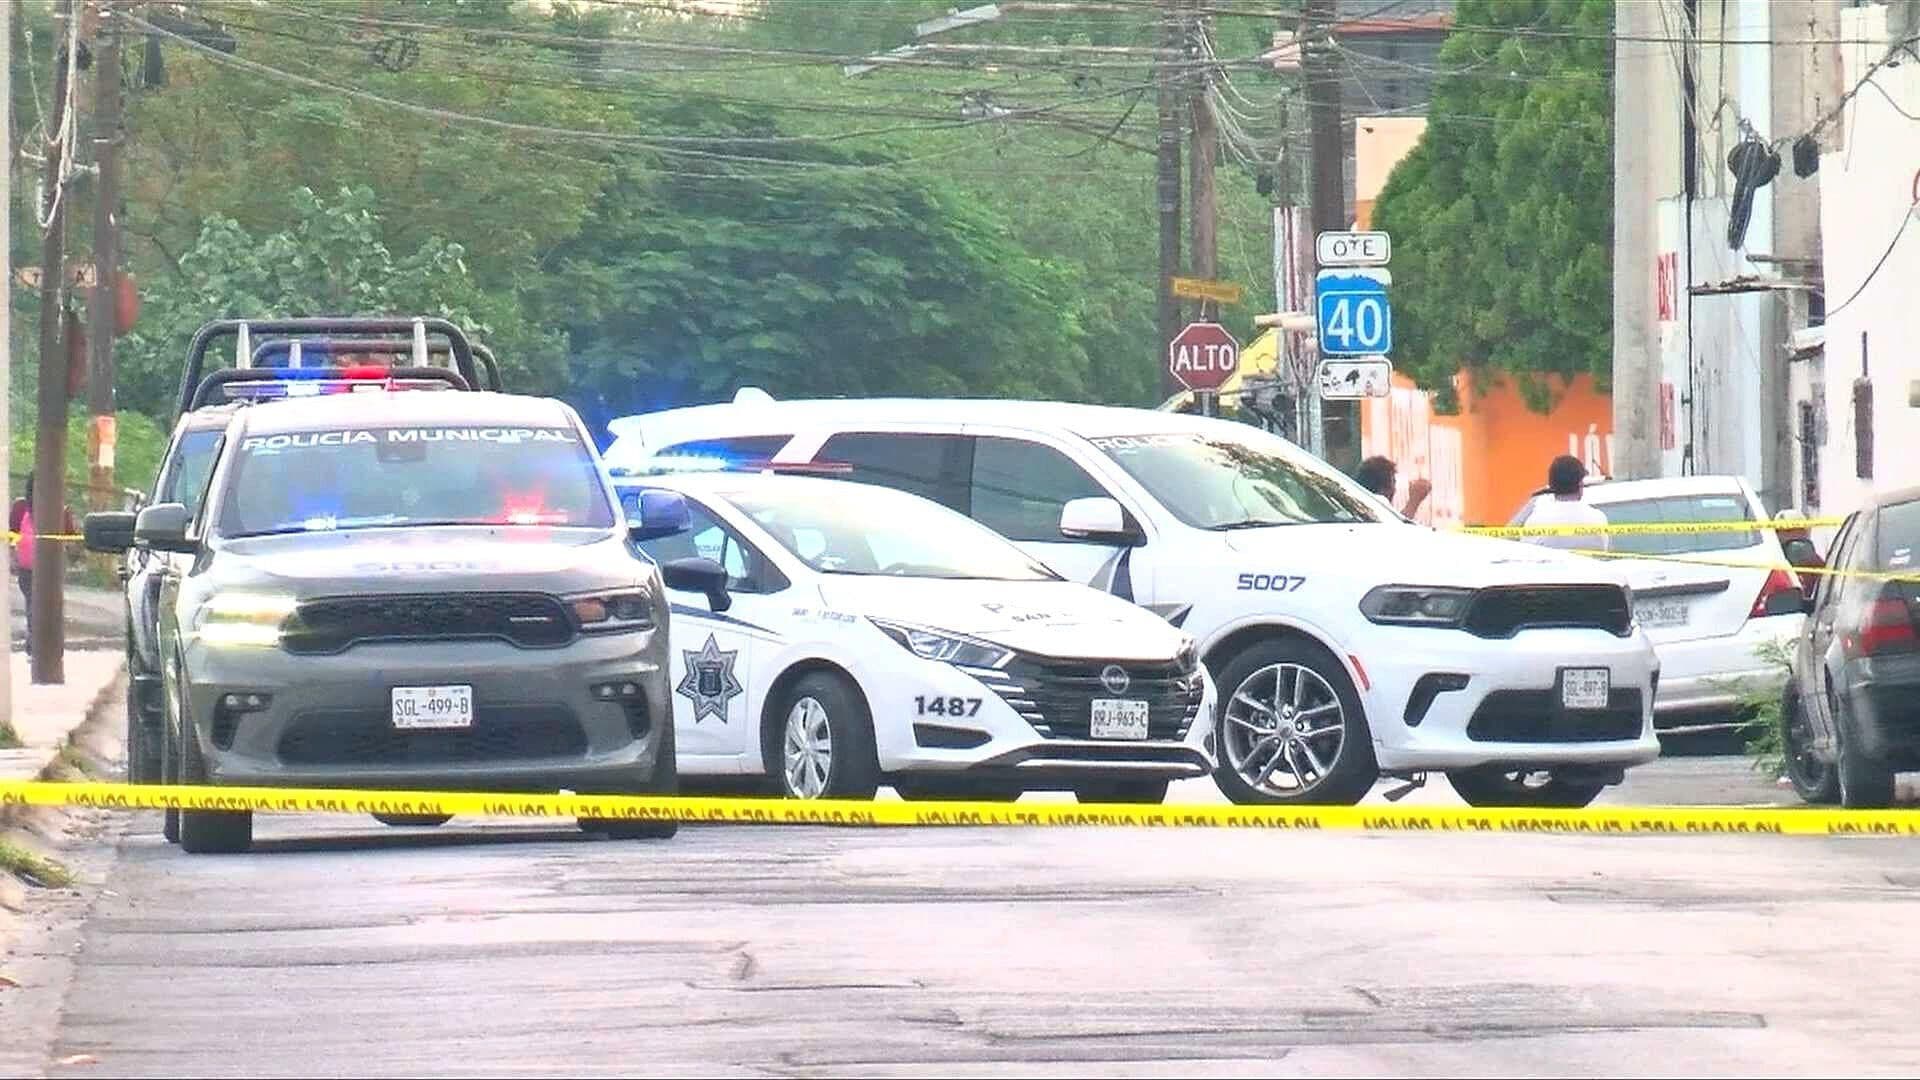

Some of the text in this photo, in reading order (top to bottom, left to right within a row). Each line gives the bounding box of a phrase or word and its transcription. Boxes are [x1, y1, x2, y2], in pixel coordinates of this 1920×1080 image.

[1327, 298, 1383, 347] 40
[1175, 344, 1235, 371] ALTO
[241, 428, 578, 451] POLICIA MUNICIPAL
[395, 697, 469, 717] SGL-499-B
[914, 695, 983, 717] 1487
